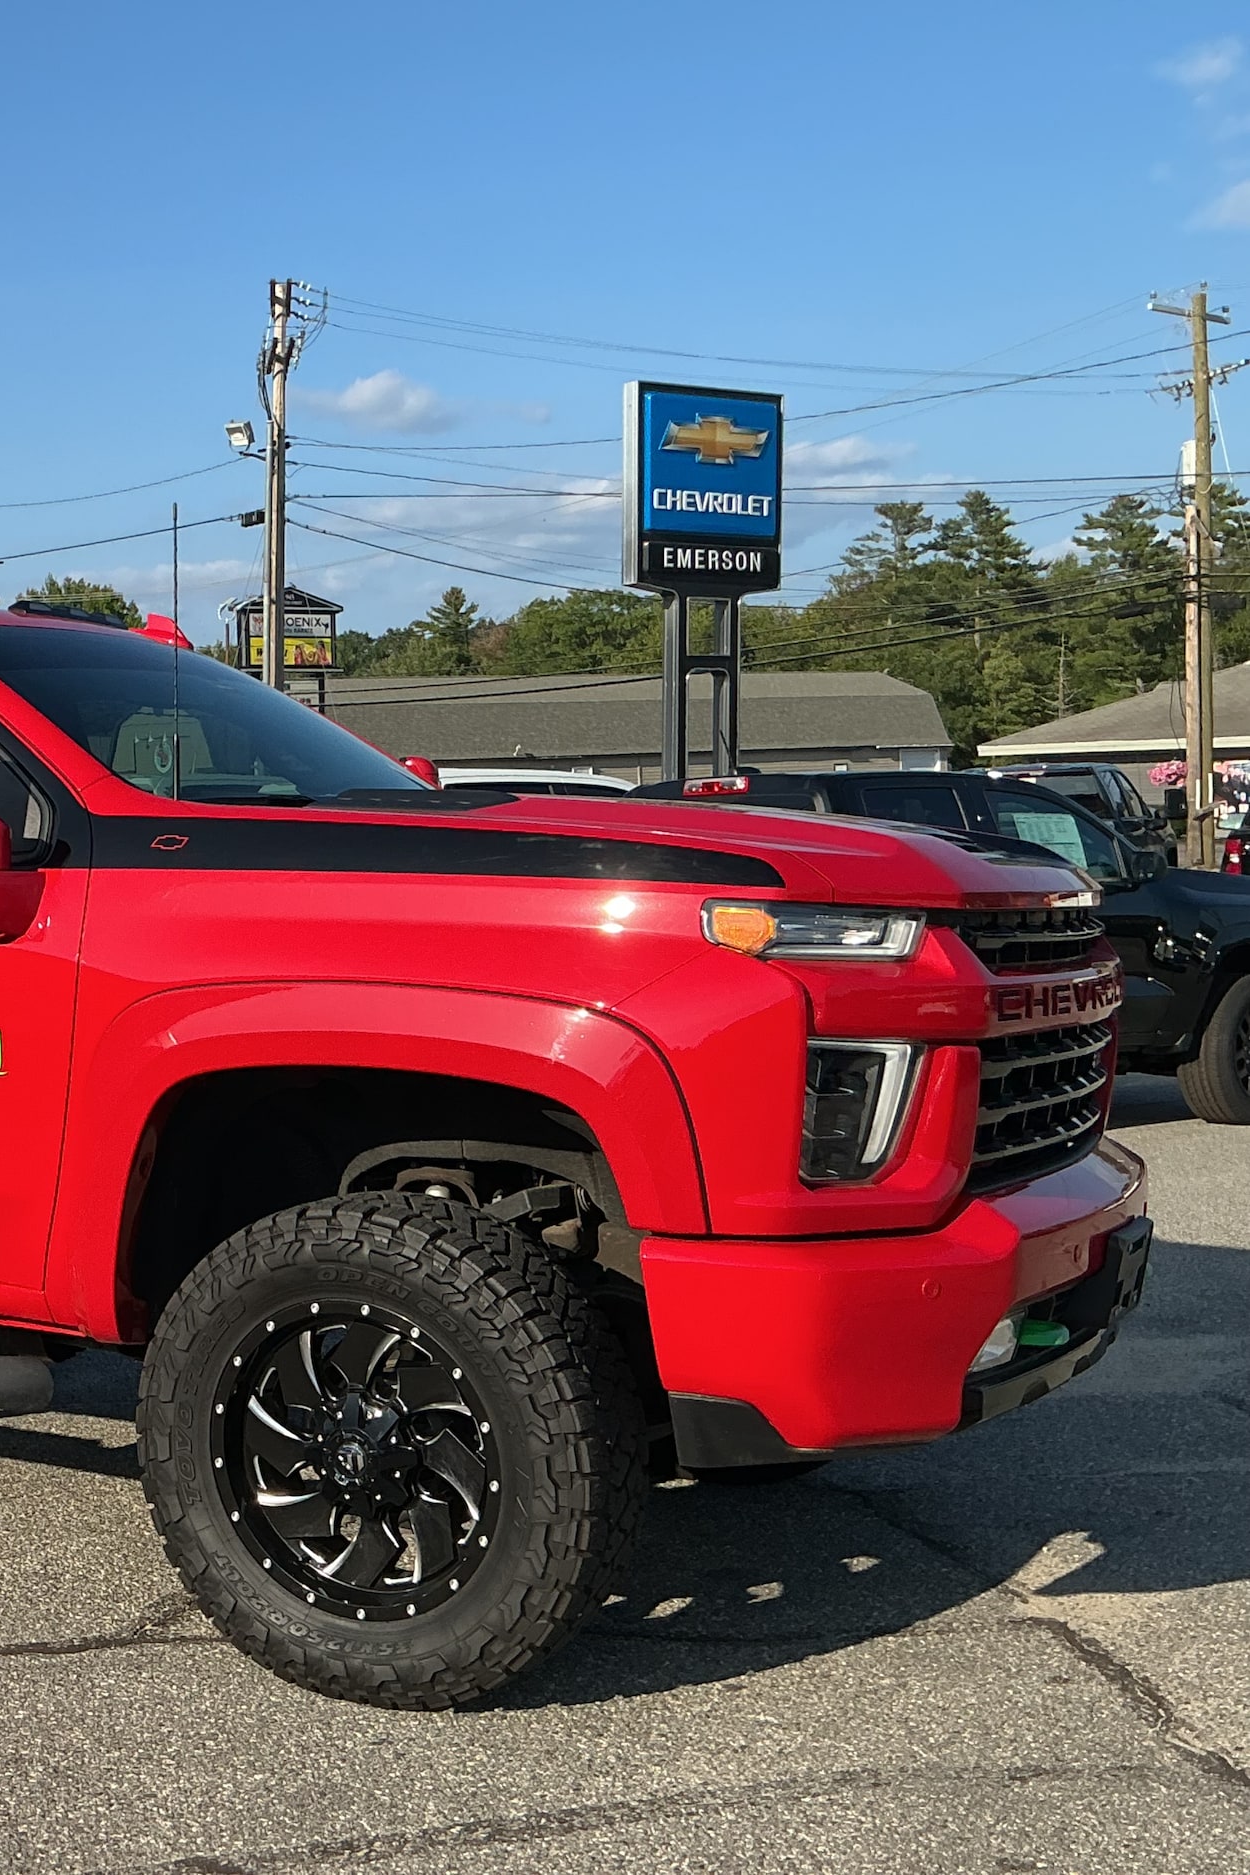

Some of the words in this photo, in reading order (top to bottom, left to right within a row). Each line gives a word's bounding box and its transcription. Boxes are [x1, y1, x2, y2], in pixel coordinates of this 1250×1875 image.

[652, 488, 773, 517] CHEVROLET
[663, 547, 762, 572] EMERSON
[285, 616, 322, 628] OENIX
[997, 979, 1121, 1021] CHEVROL
[317, 1264, 413, 1299] OPEN
[174, 1403, 202, 1505] TOYO
